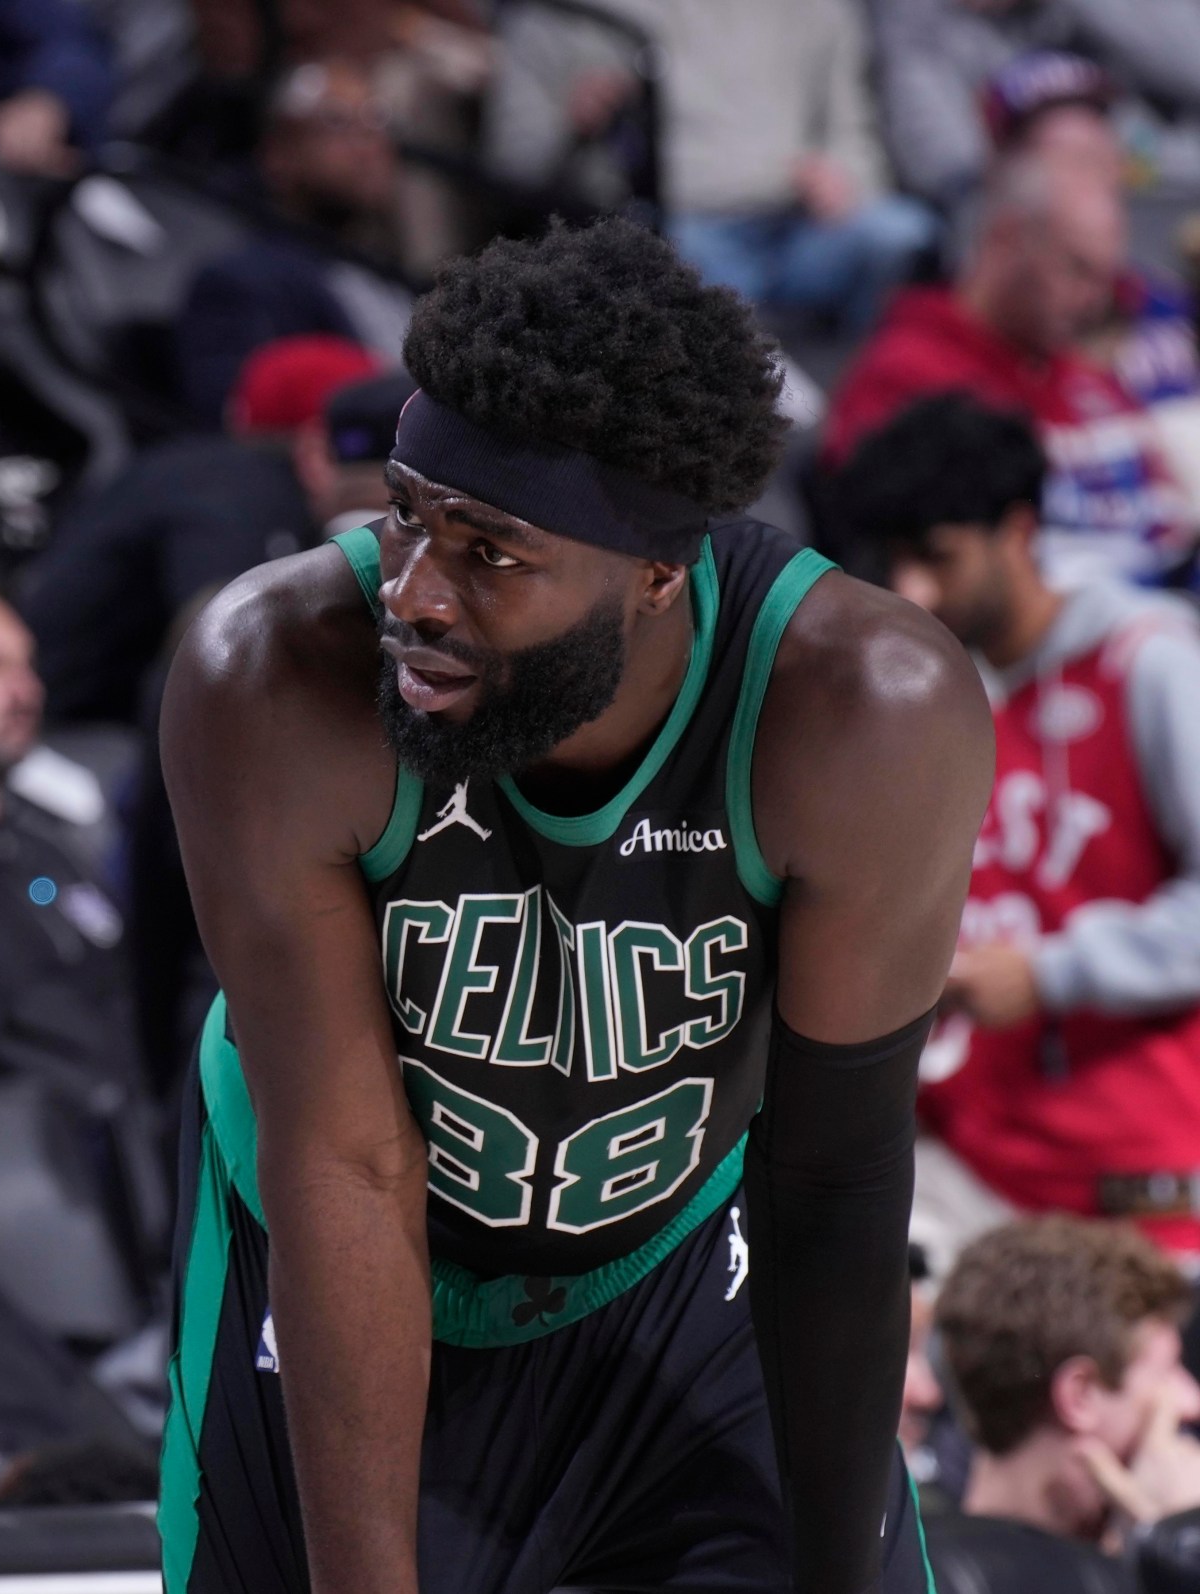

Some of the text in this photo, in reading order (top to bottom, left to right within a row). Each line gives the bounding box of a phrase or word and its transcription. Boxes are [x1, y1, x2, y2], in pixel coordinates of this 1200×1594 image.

[620, 818, 727, 857] Amica
[382, 884, 748, 1082] CELTICS
[400, 1054, 715, 1235] 88
